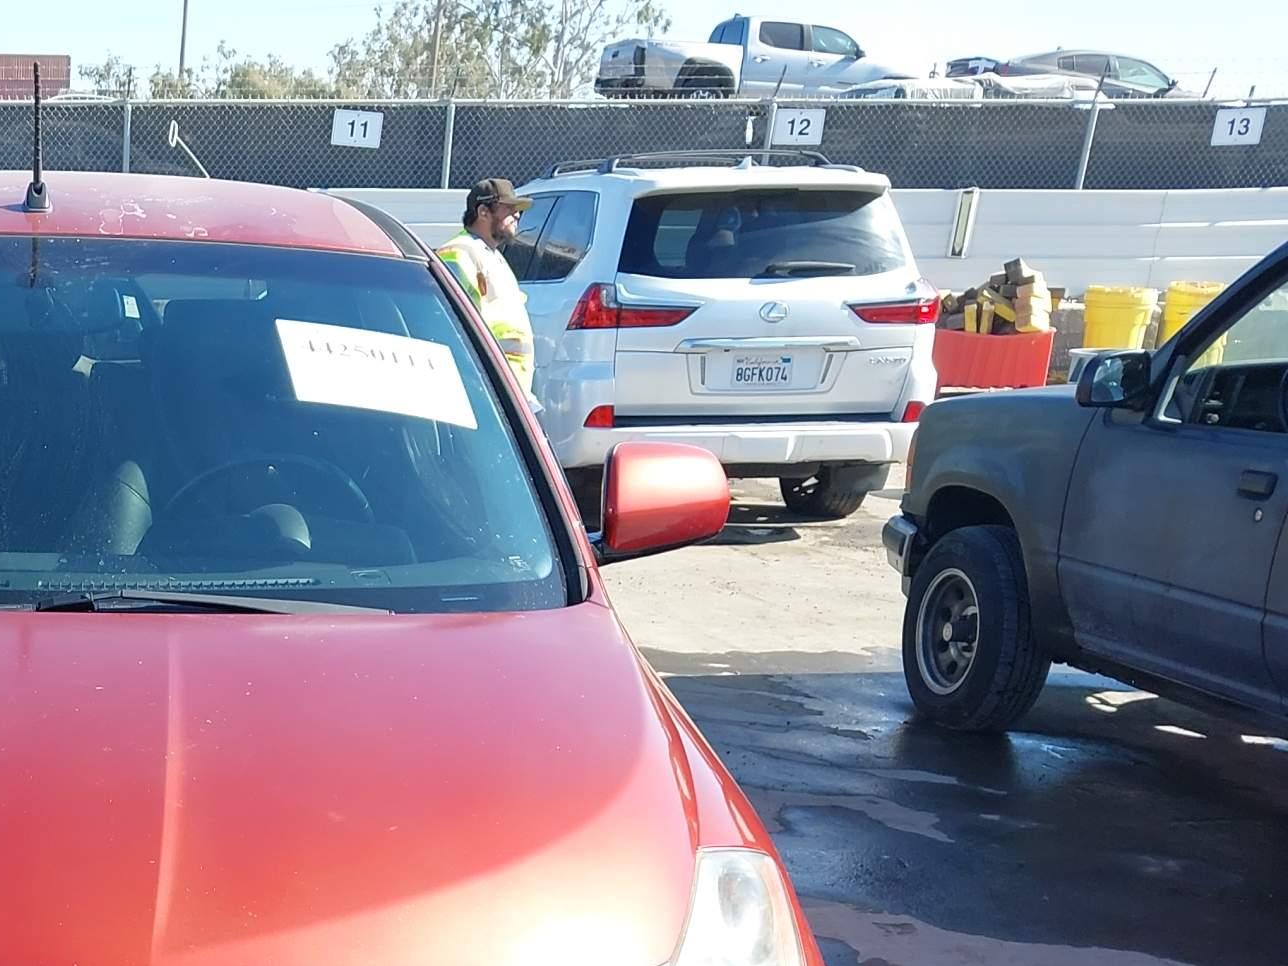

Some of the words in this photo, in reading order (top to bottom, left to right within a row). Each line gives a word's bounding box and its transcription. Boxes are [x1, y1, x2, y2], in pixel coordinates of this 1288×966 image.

[347, 119, 368, 138] 11
[787, 118, 811, 136] 12
[1227, 117, 1251, 136] 13
[735, 366, 788, 382] 8GFK074
